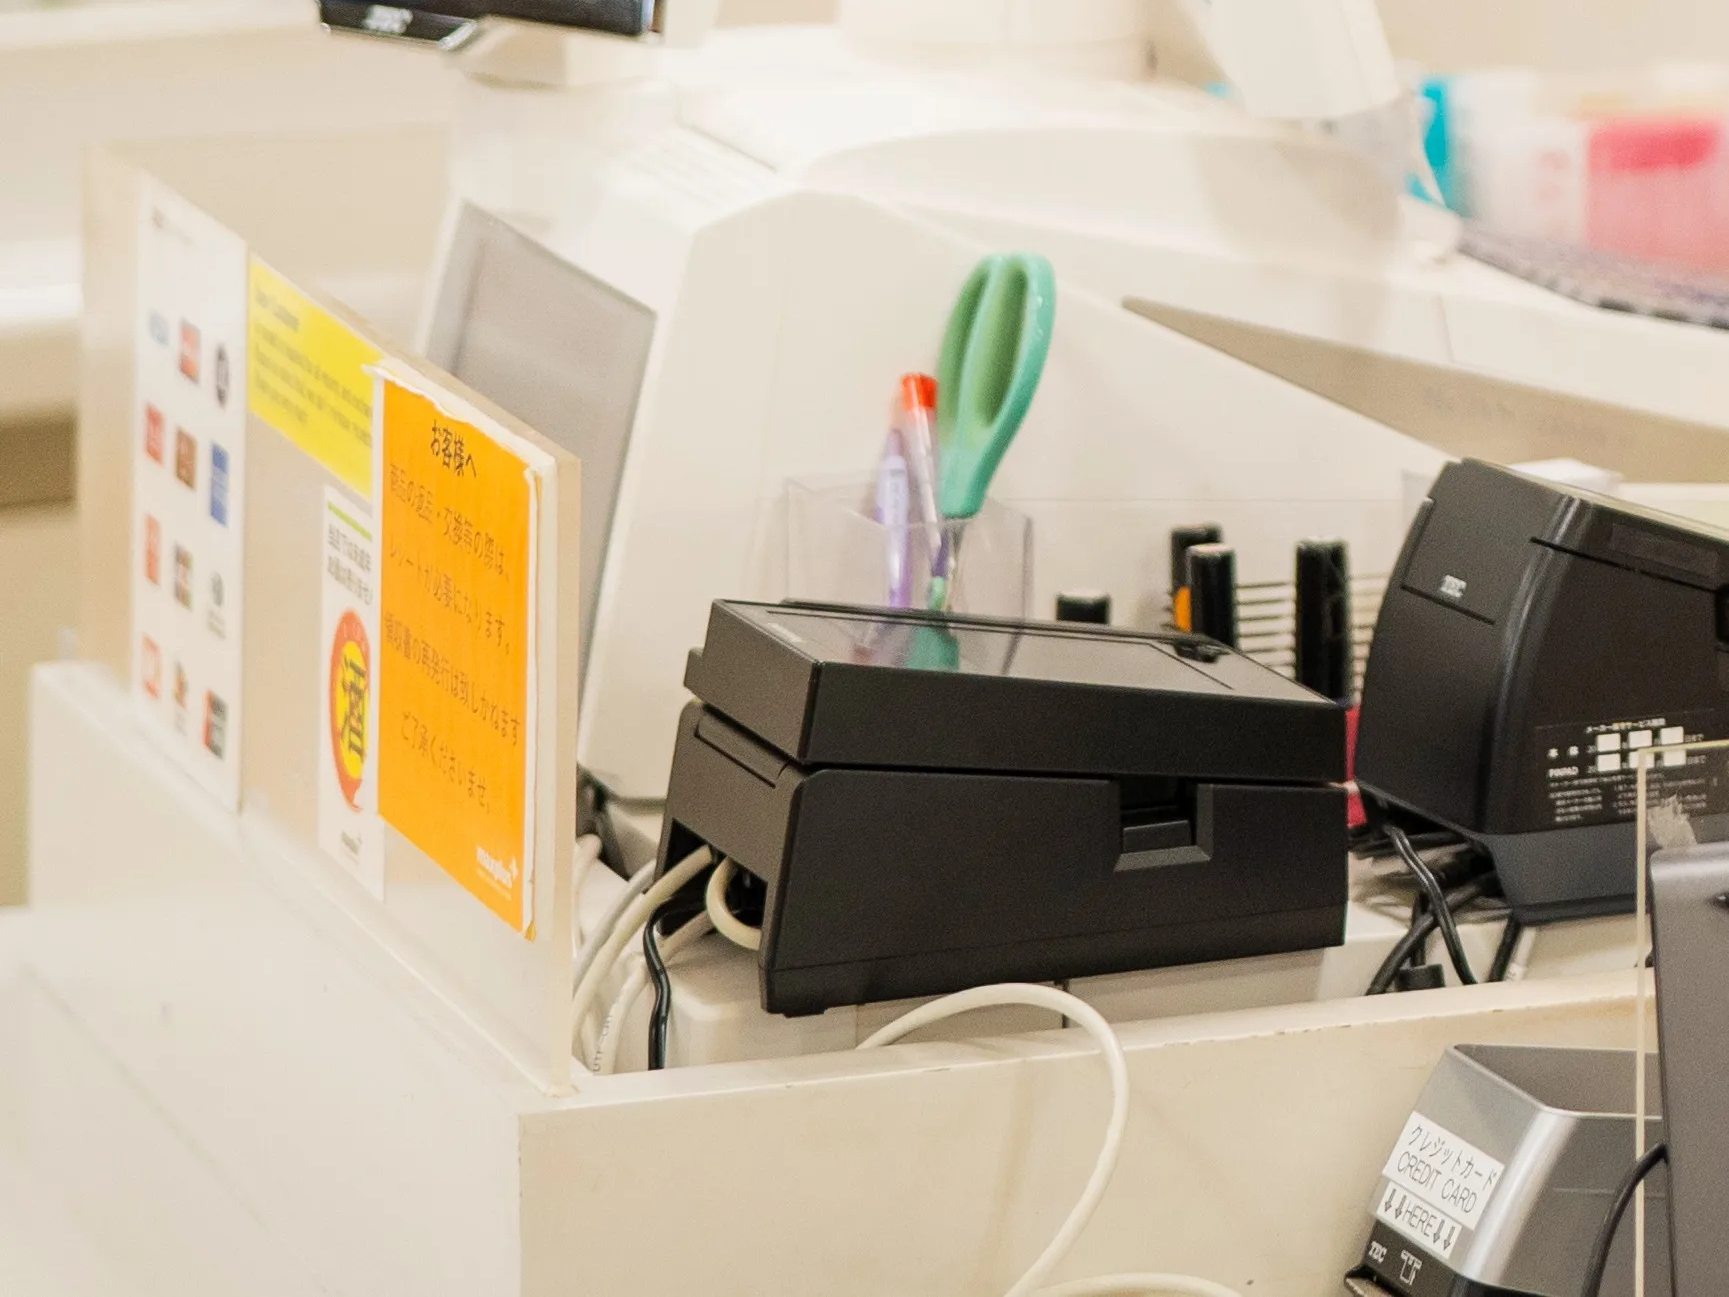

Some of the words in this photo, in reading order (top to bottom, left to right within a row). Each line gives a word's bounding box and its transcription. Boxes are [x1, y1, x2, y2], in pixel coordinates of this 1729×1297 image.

[430, 420, 477, 477] お客様へ
[1397, 1151, 1442, 1190] CREDIT
[1441, 1179, 1478, 1214] CARD
[1408, 1126, 1497, 1194] クレジットカード
[1402, 1203, 1437, 1238] HERE
